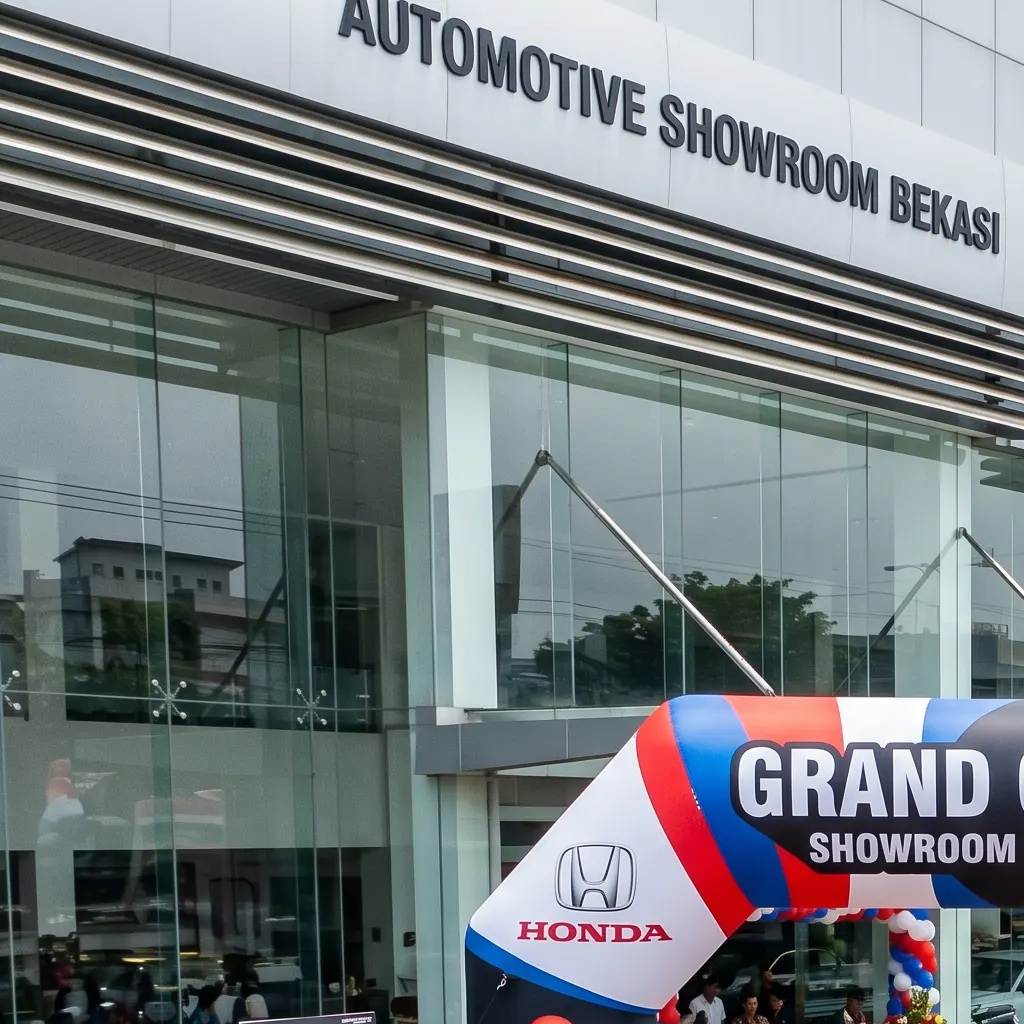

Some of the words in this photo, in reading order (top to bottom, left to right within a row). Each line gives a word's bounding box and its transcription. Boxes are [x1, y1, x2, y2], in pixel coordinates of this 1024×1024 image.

[338, 0, 647, 136] AUTOMOTIVE
[660, 93, 879, 214] SHOWROOM
[890, 175, 1000, 254] BEKASI
[737, 746, 991, 818] GRAND
[809, 832, 1016, 864] SHOWROOM
[516, 921, 673, 943] HONDA
